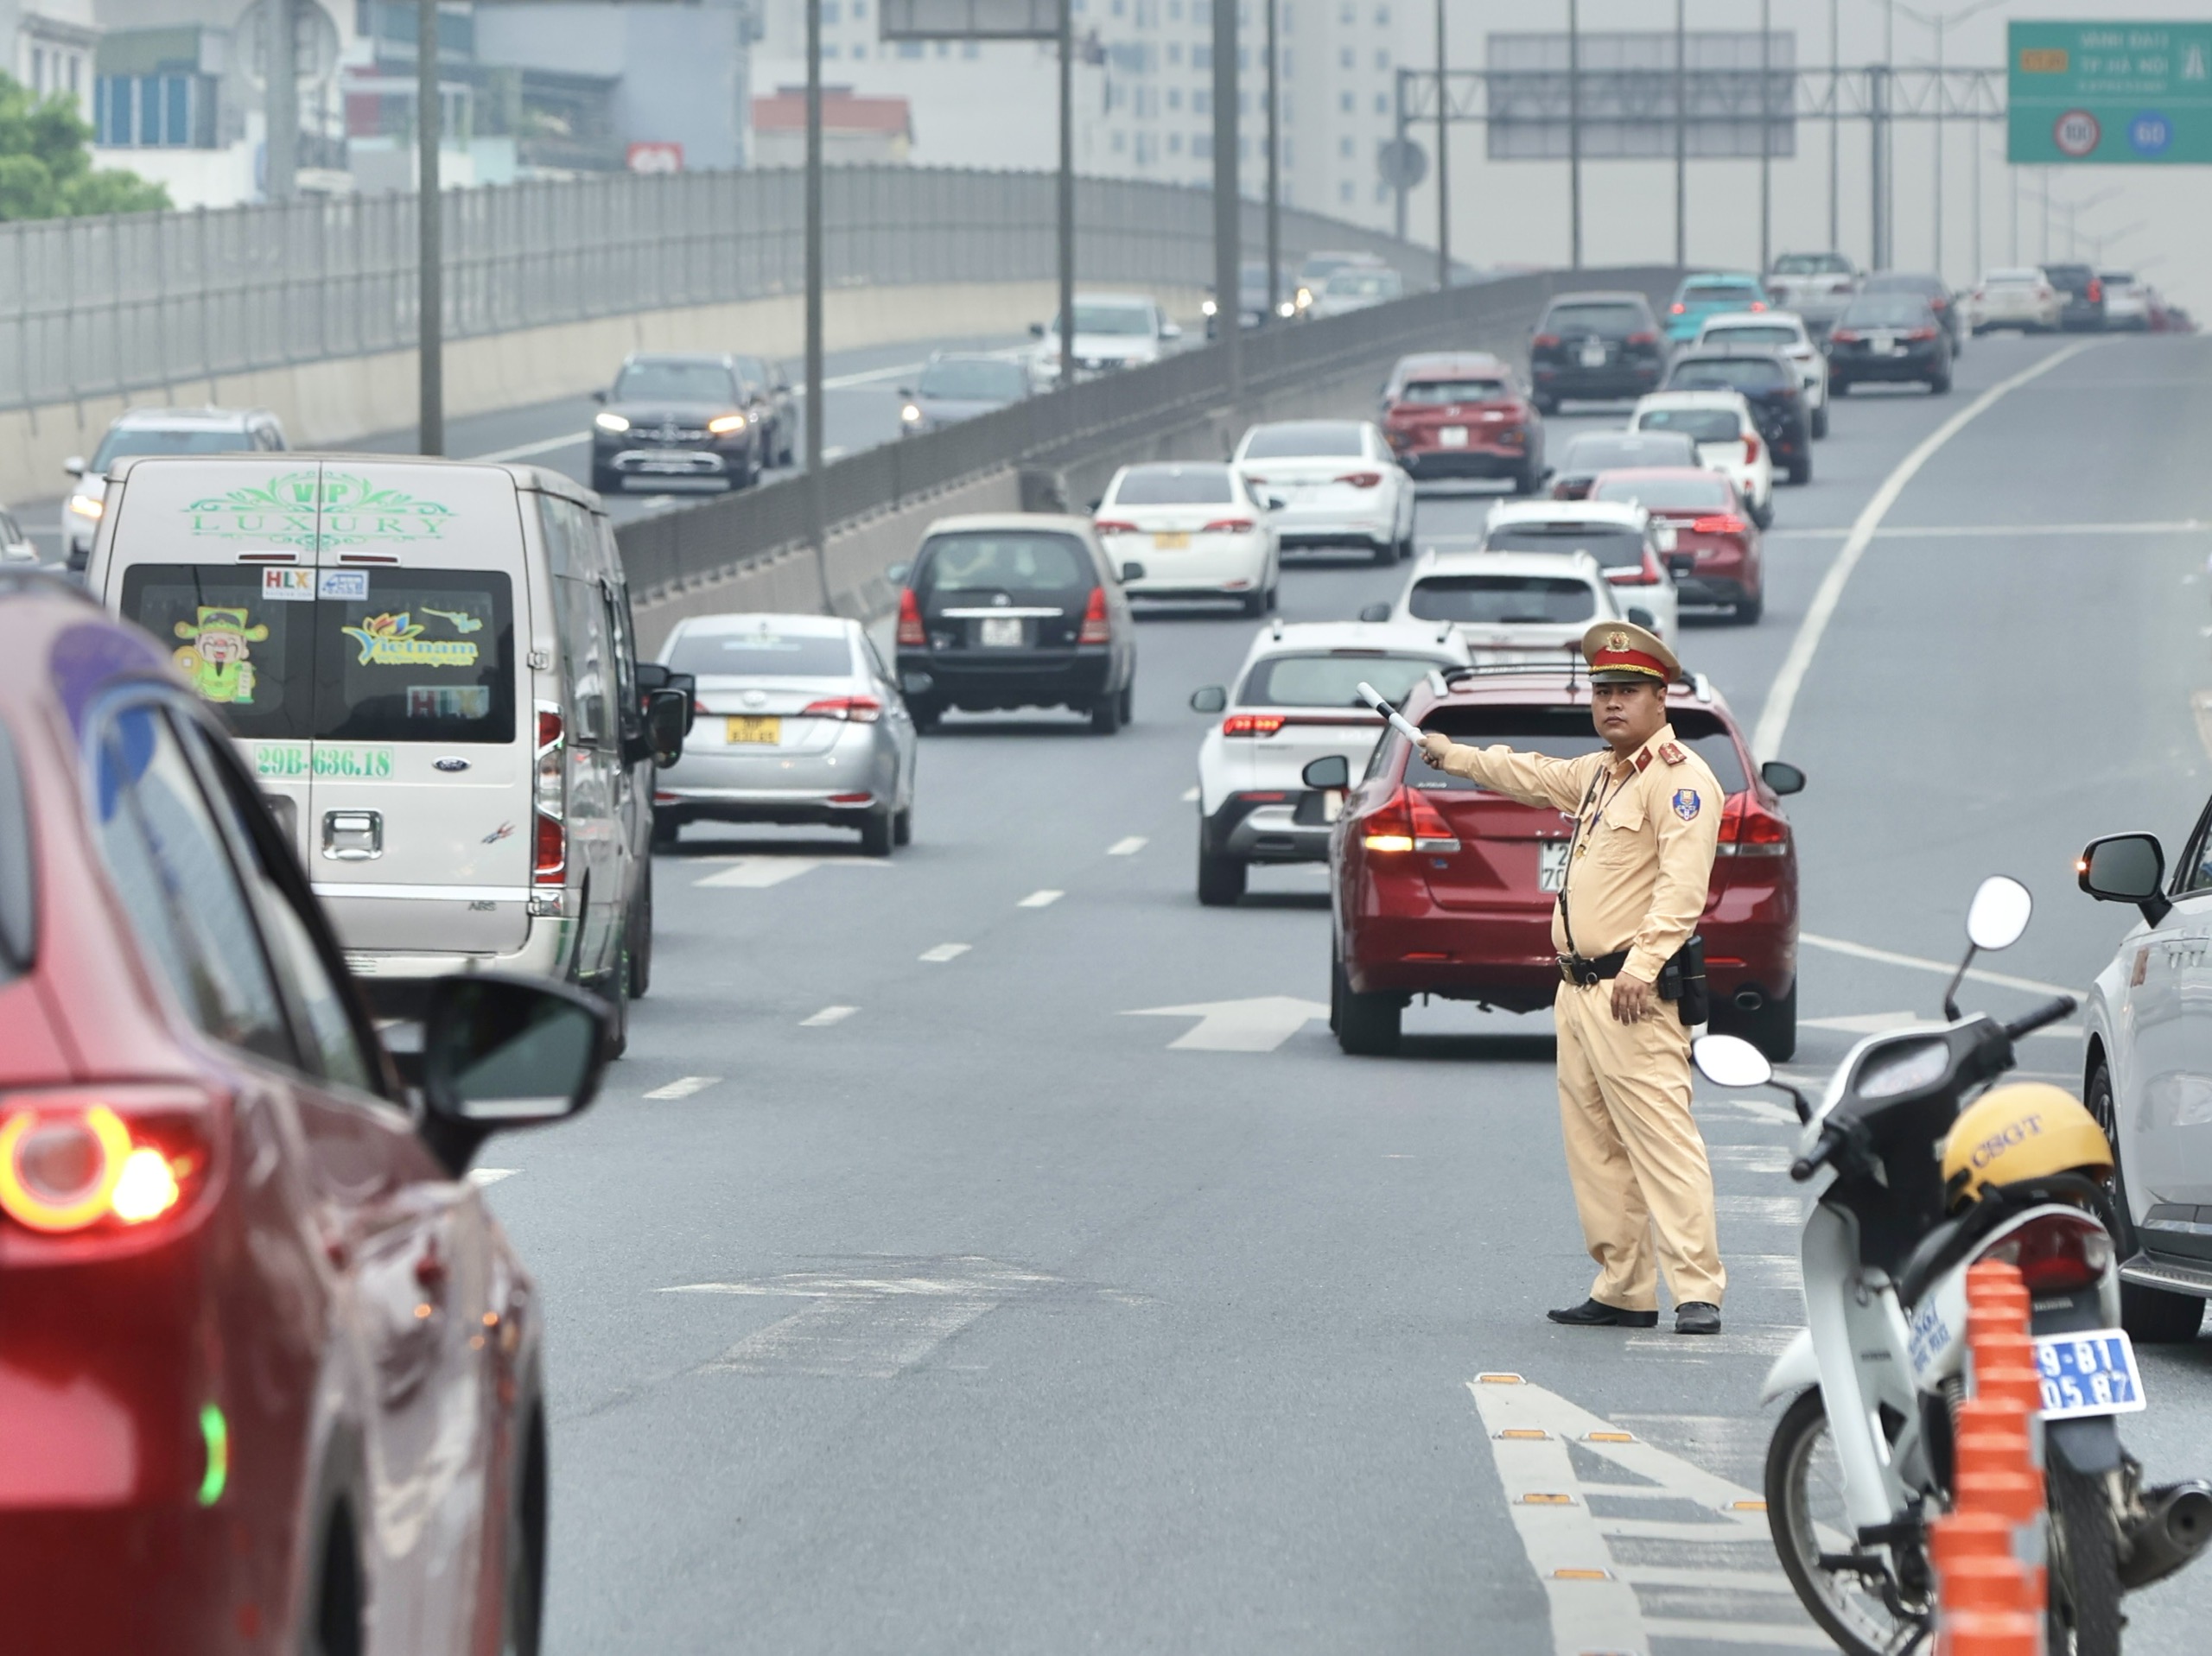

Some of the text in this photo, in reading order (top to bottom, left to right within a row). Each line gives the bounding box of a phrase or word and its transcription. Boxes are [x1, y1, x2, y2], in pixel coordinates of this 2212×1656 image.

[292, 484, 349, 503] VIP
[192, 514, 447, 533] LUXURY
[266, 571, 308, 588] HLX
[258, 746, 389, 776] 29B-636.18
[1973, 1114, 2041, 1168] CSGT
[2040, 1341, 2113, 1378] 9-B1
